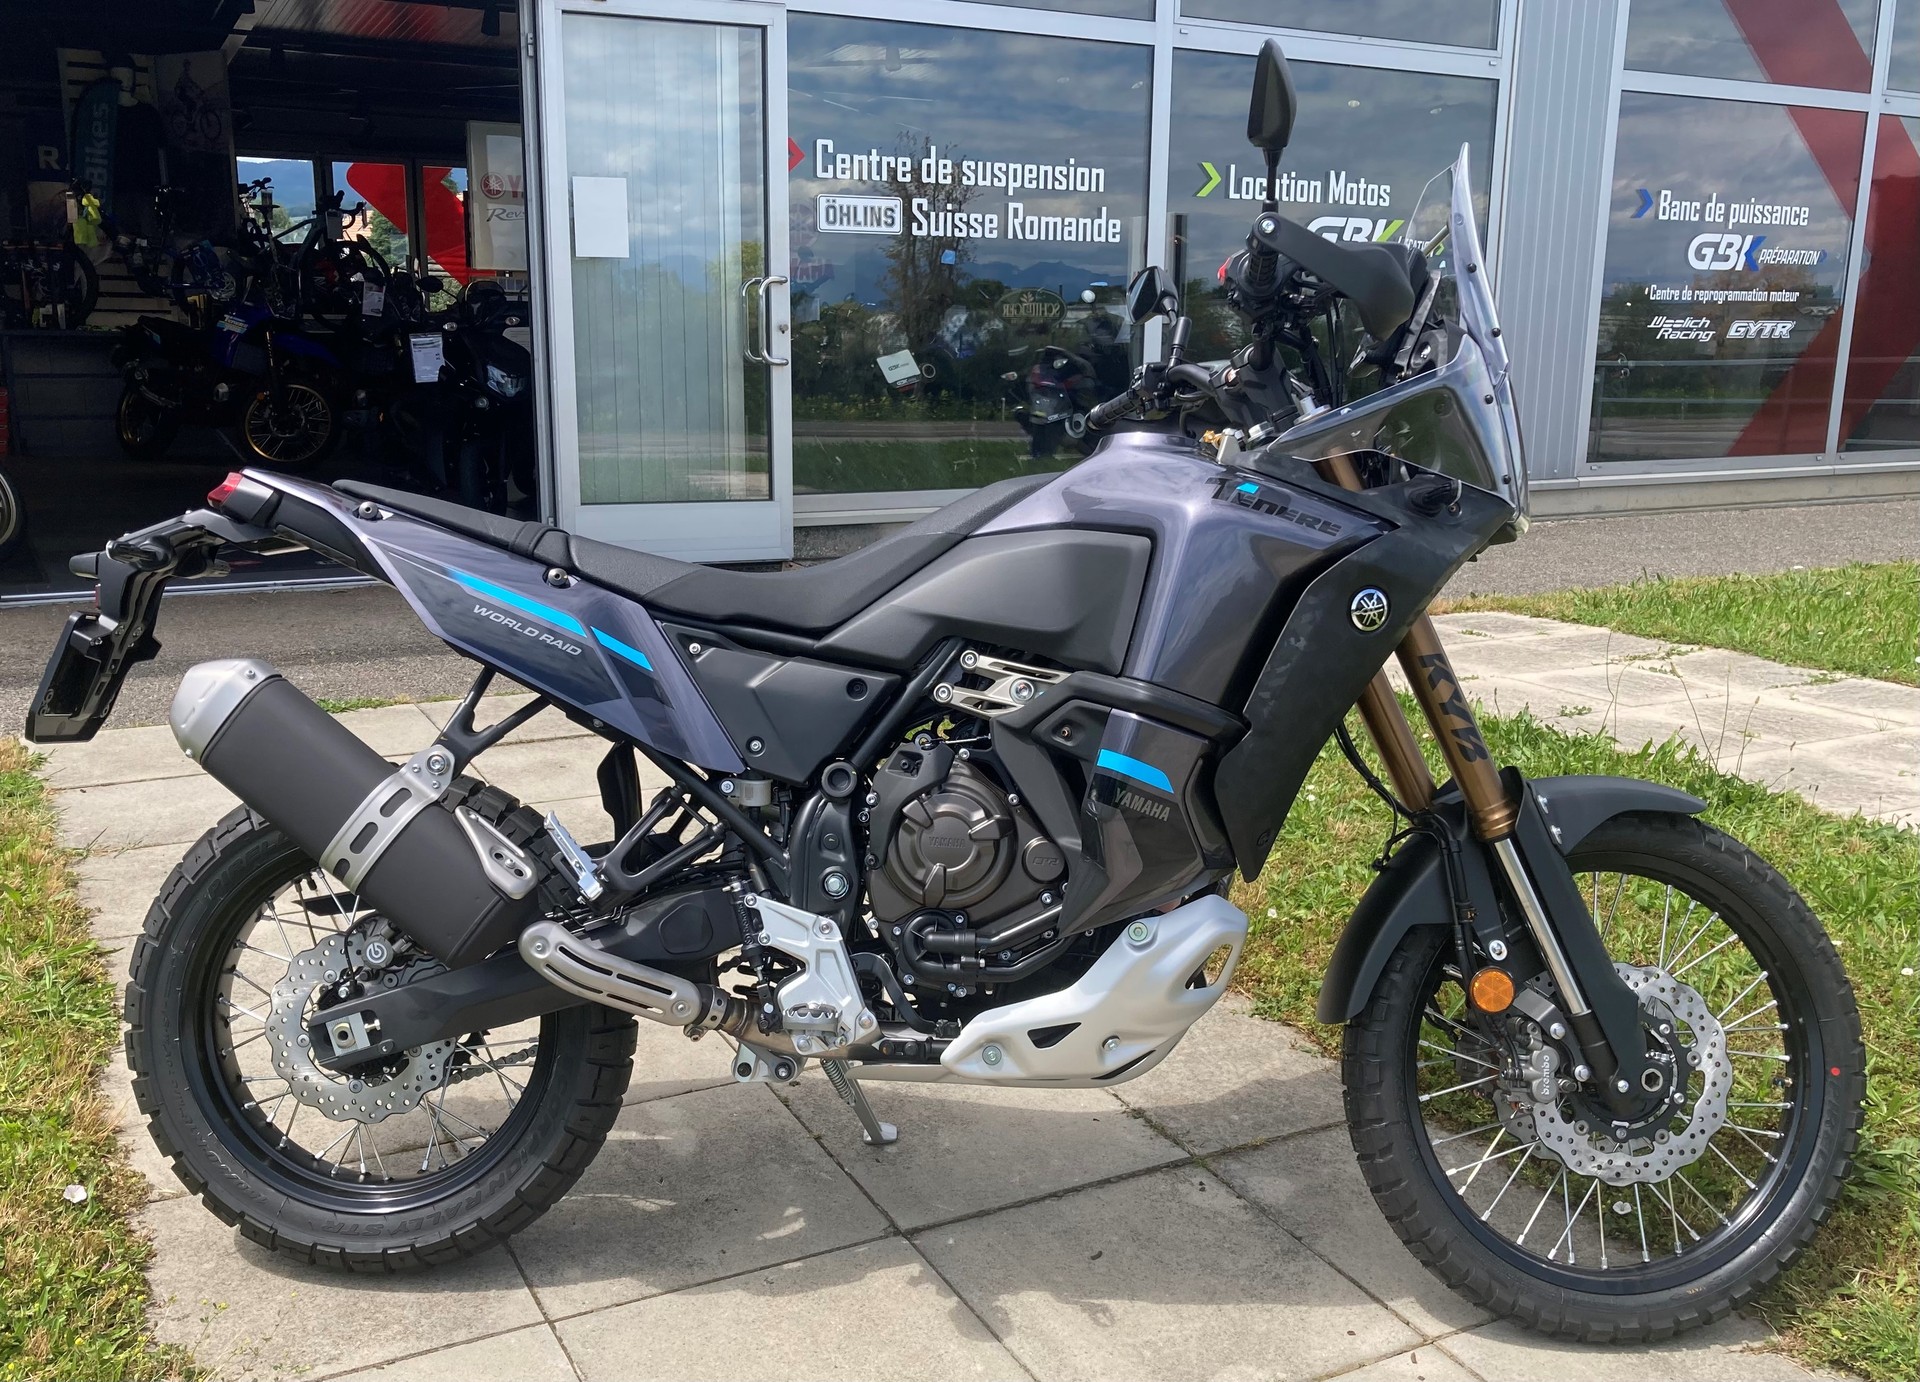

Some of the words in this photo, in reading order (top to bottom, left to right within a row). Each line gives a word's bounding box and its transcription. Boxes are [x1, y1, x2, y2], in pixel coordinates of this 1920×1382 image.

[816, 138, 912, 183] Centre
[921, 145, 952, 185] de
[961, 158, 1105, 195] suspension
[1229, 163, 1322, 204] Loction
[1328, 169, 1391, 207] Motos
[824, 198, 897, 229] ÖHLINS
[911, 197, 998, 238] Suisse
[1007, 202, 1122, 243] Romande
[1658, 189, 1701, 221] Banc
[1704, 192, 1726, 223] de
[1728, 198, 1810, 230] puissance
[1687, 233, 1767, 272] GBK
[1758, 246, 1821, 266] PRÉPARATION
[1649, 284, 1681, 301] Centre
[1682, 284, 1692, 301] de
[1694, 287, 1768, 305] reprogrammation
[1769, 290, 1800, 303] moteur
[1656, 327, 1717, 343] Racing
[1726, 319, 1796, 339] GYTR
[473, 604, 540, 638] WORLD
[538, 633, 582, 656] RAID
[1417, 652, 1489, 763] KYB
[1115, 786, 1171, 822] YAMAHA
[928, 835, 967, 849] YAMAHA
[1540, 1054, 1551, 1096] brembo
[323, 1218, 387, 1238] STR
[391, 1192, 484, 1234] RALLY
